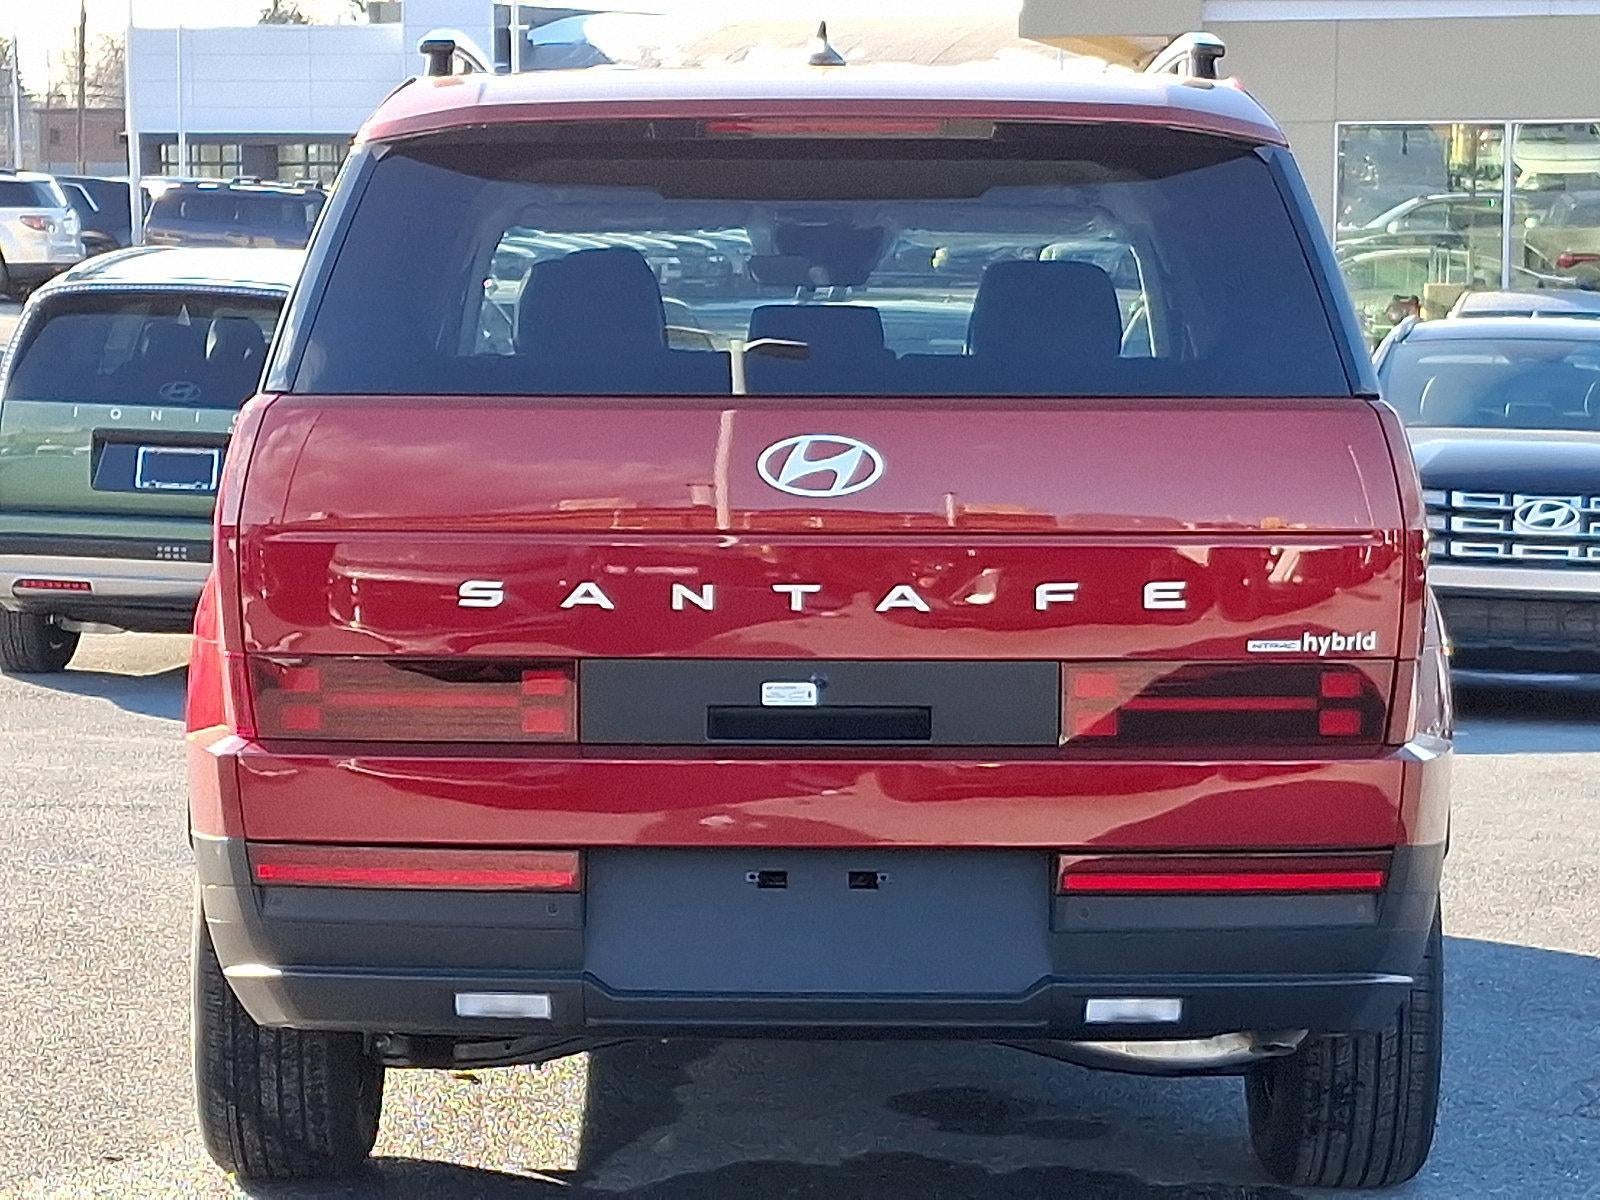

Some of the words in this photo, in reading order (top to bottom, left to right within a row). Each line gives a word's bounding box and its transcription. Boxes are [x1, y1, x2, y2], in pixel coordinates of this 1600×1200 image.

[458, 580, 930, 611] SANTA
[1035, 581, 1187, 611] FE
[1303, 630, 1376, 656] hybrid
